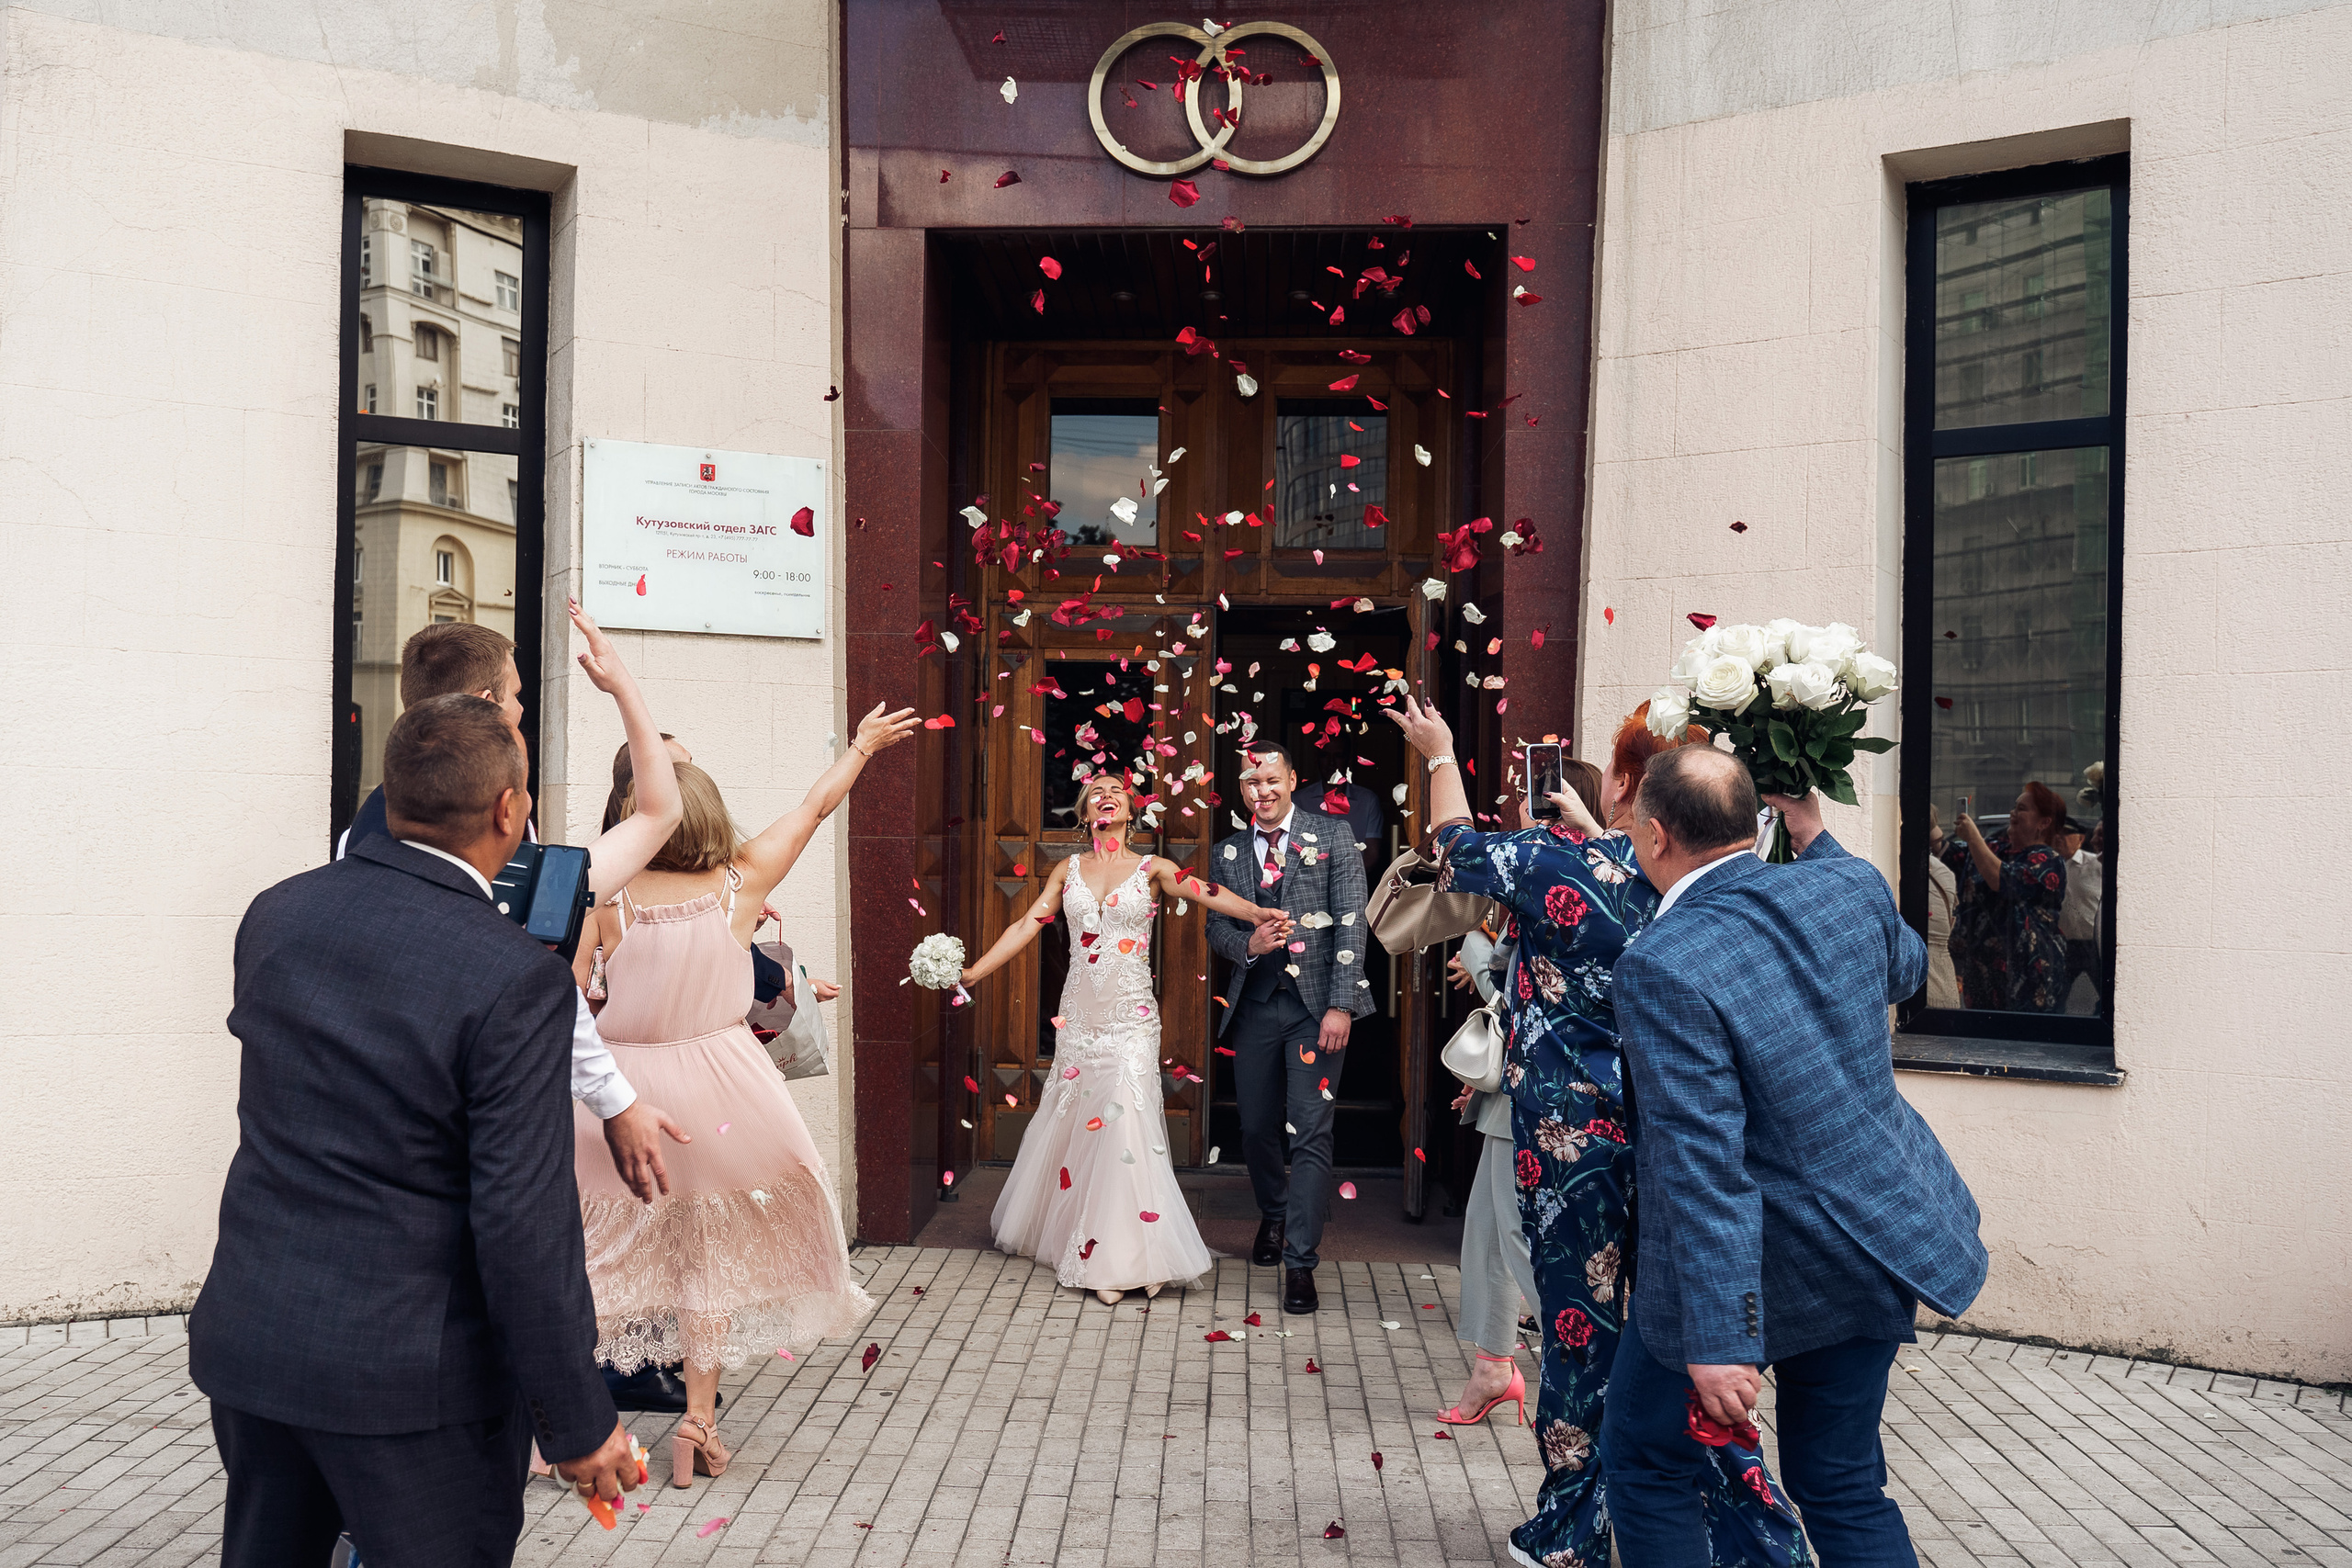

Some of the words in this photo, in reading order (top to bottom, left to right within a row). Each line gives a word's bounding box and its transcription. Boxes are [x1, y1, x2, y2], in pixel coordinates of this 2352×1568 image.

[636, 515, 710, 530] Кутузовский
[713, 525, 746, 534] отдел
[749, 525, 777, 536] ЗАГС
[666, 548, 705, 560] РЕЖИМ
[708, 551, 748, 563] РАБОТЫ
[752, 570, 775, 580] 9:00
[786, 571, 811, 582] 18:00
